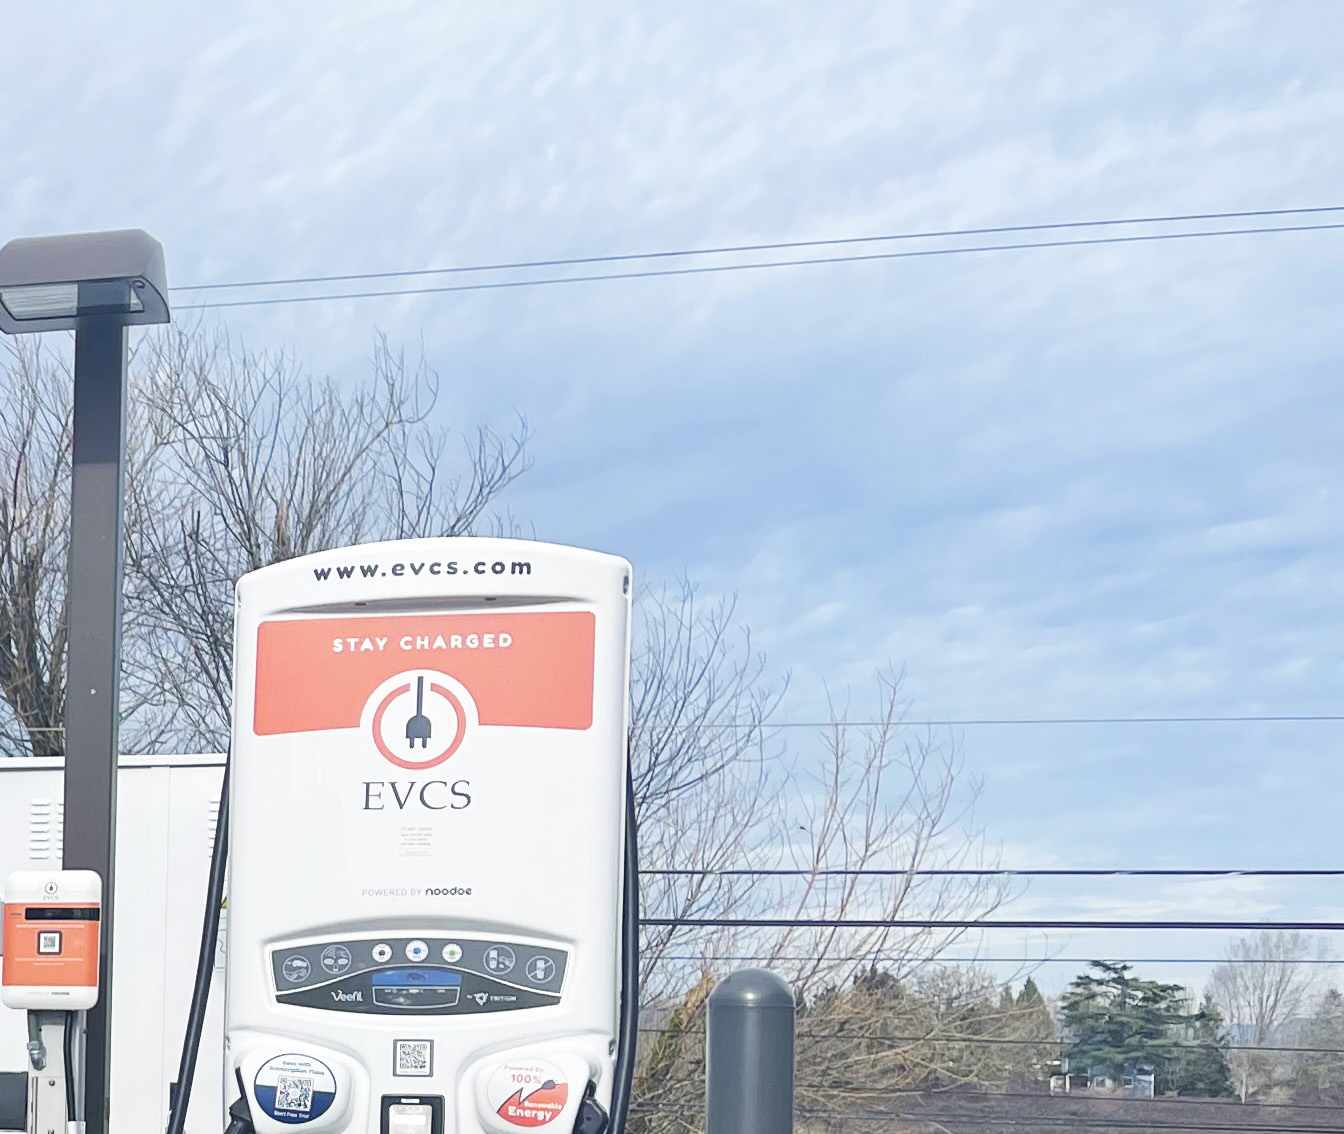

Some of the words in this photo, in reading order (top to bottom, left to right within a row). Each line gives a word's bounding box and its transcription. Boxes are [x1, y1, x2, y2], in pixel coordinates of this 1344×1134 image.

[313, 560, 532, 582] www.evcs.com
[332, 637, 389, 653] STAY
[399, 633, 513, 651] CHARGED
[360, 779, 472, 811] EVCS
[361, 888, 408, 897] POWERED
[410, 888, 423, 897] BY
[425, 886, 473, 896] noodoe
[330, 989, 364, 1002] Veefil
[511, 1073, 543, 1085] 100%
[507, 1105, 553, 1122] Energy
